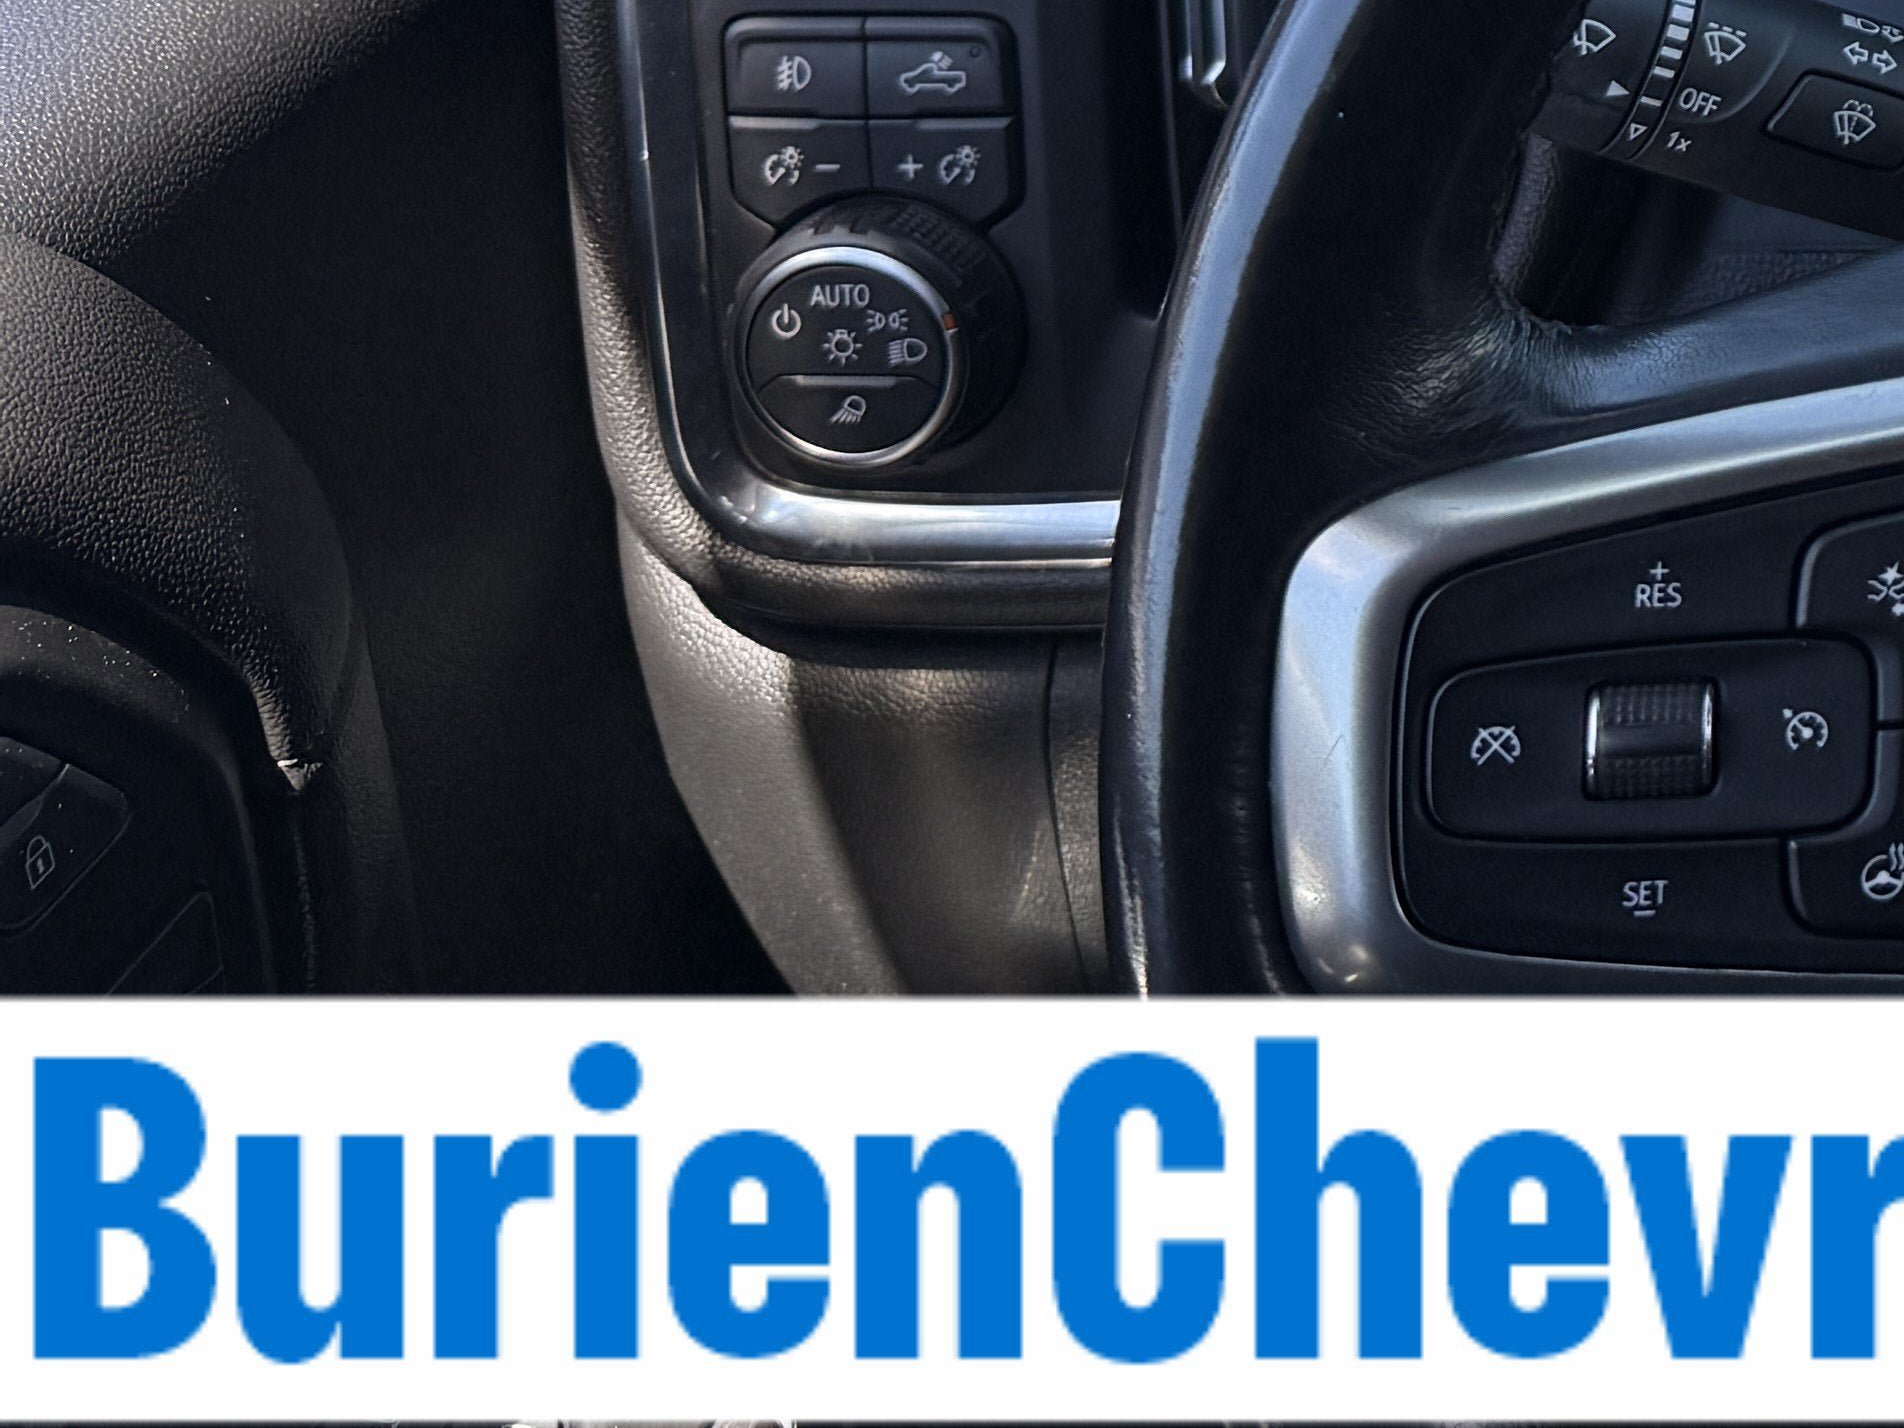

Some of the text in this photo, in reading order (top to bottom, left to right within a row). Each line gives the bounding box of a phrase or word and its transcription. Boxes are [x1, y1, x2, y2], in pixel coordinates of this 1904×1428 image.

[1679, 87, 1722, 116] OFF
[1667, 131, 1692, 152] 1x
[810, 284, 869, 307] AUTO
[1635, 582, 1682, 608] RES
[1622, 879, 1668, 907] SET
